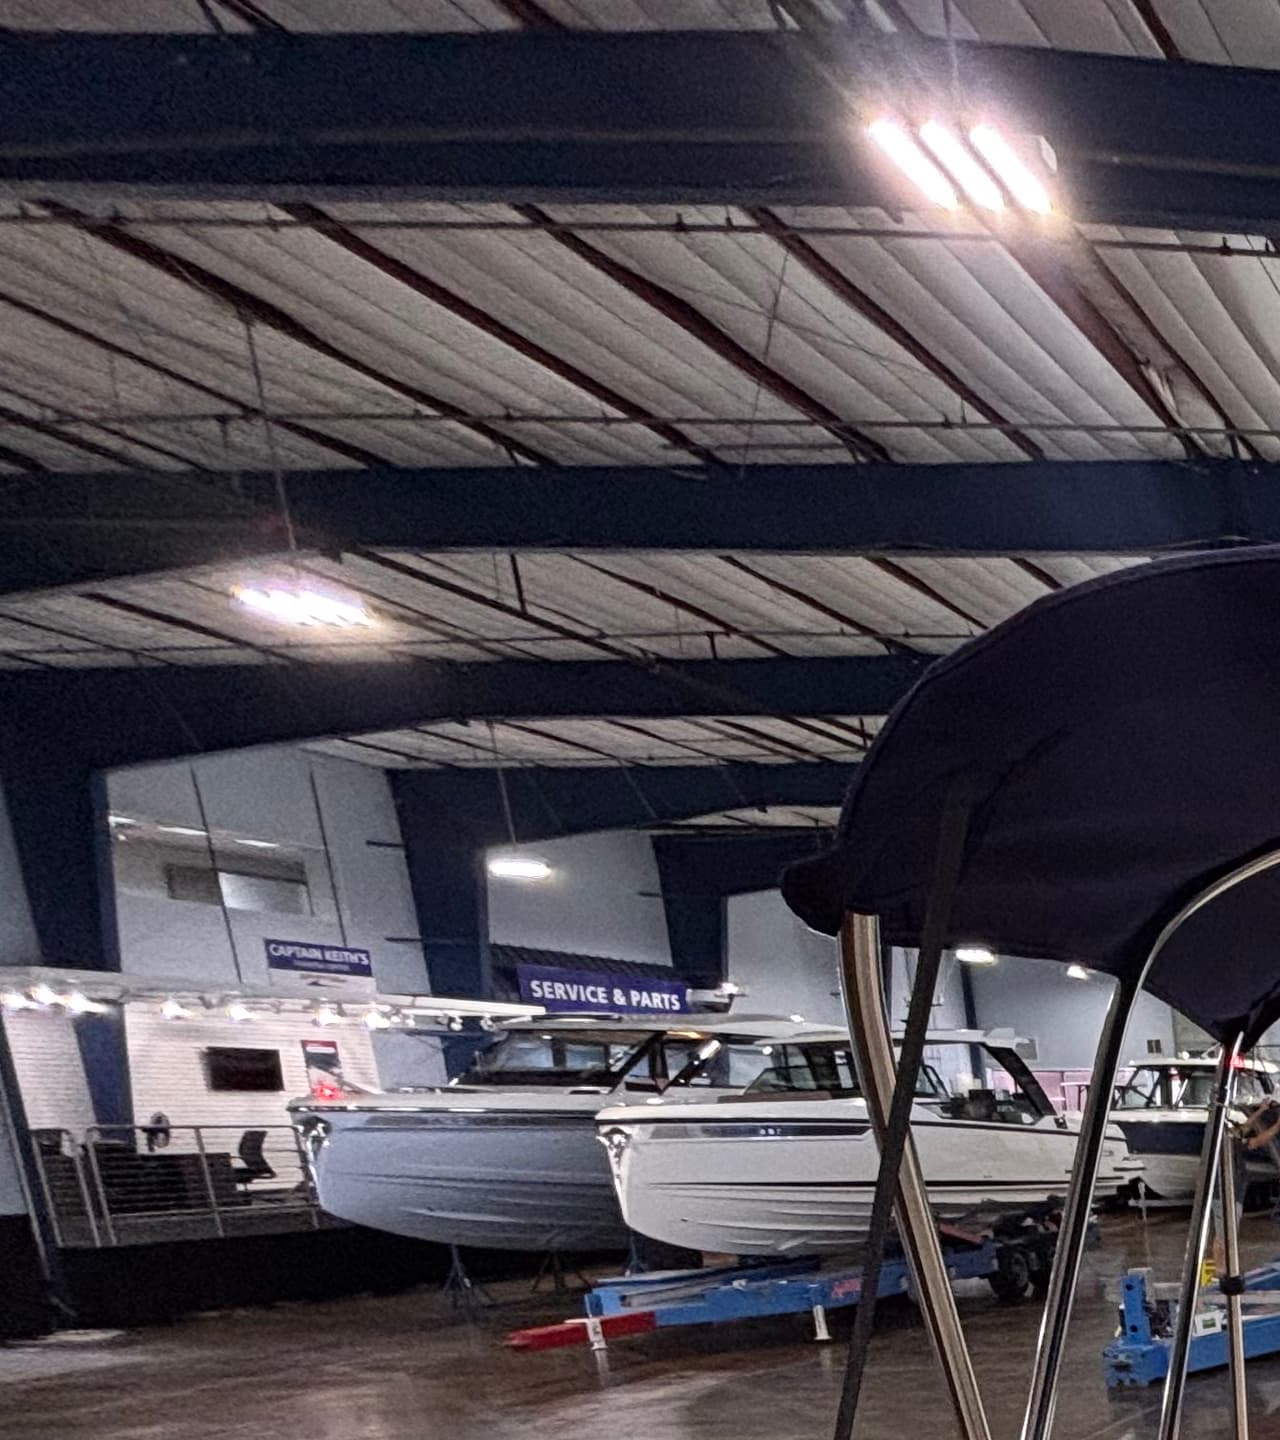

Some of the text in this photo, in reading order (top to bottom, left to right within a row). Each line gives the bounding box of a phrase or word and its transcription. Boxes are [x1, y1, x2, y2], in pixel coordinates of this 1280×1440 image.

[269, 943, 369, 965] CAPTAIN KEITH'S
[530, 980, 681, 1010] SERVICE & PARTS
